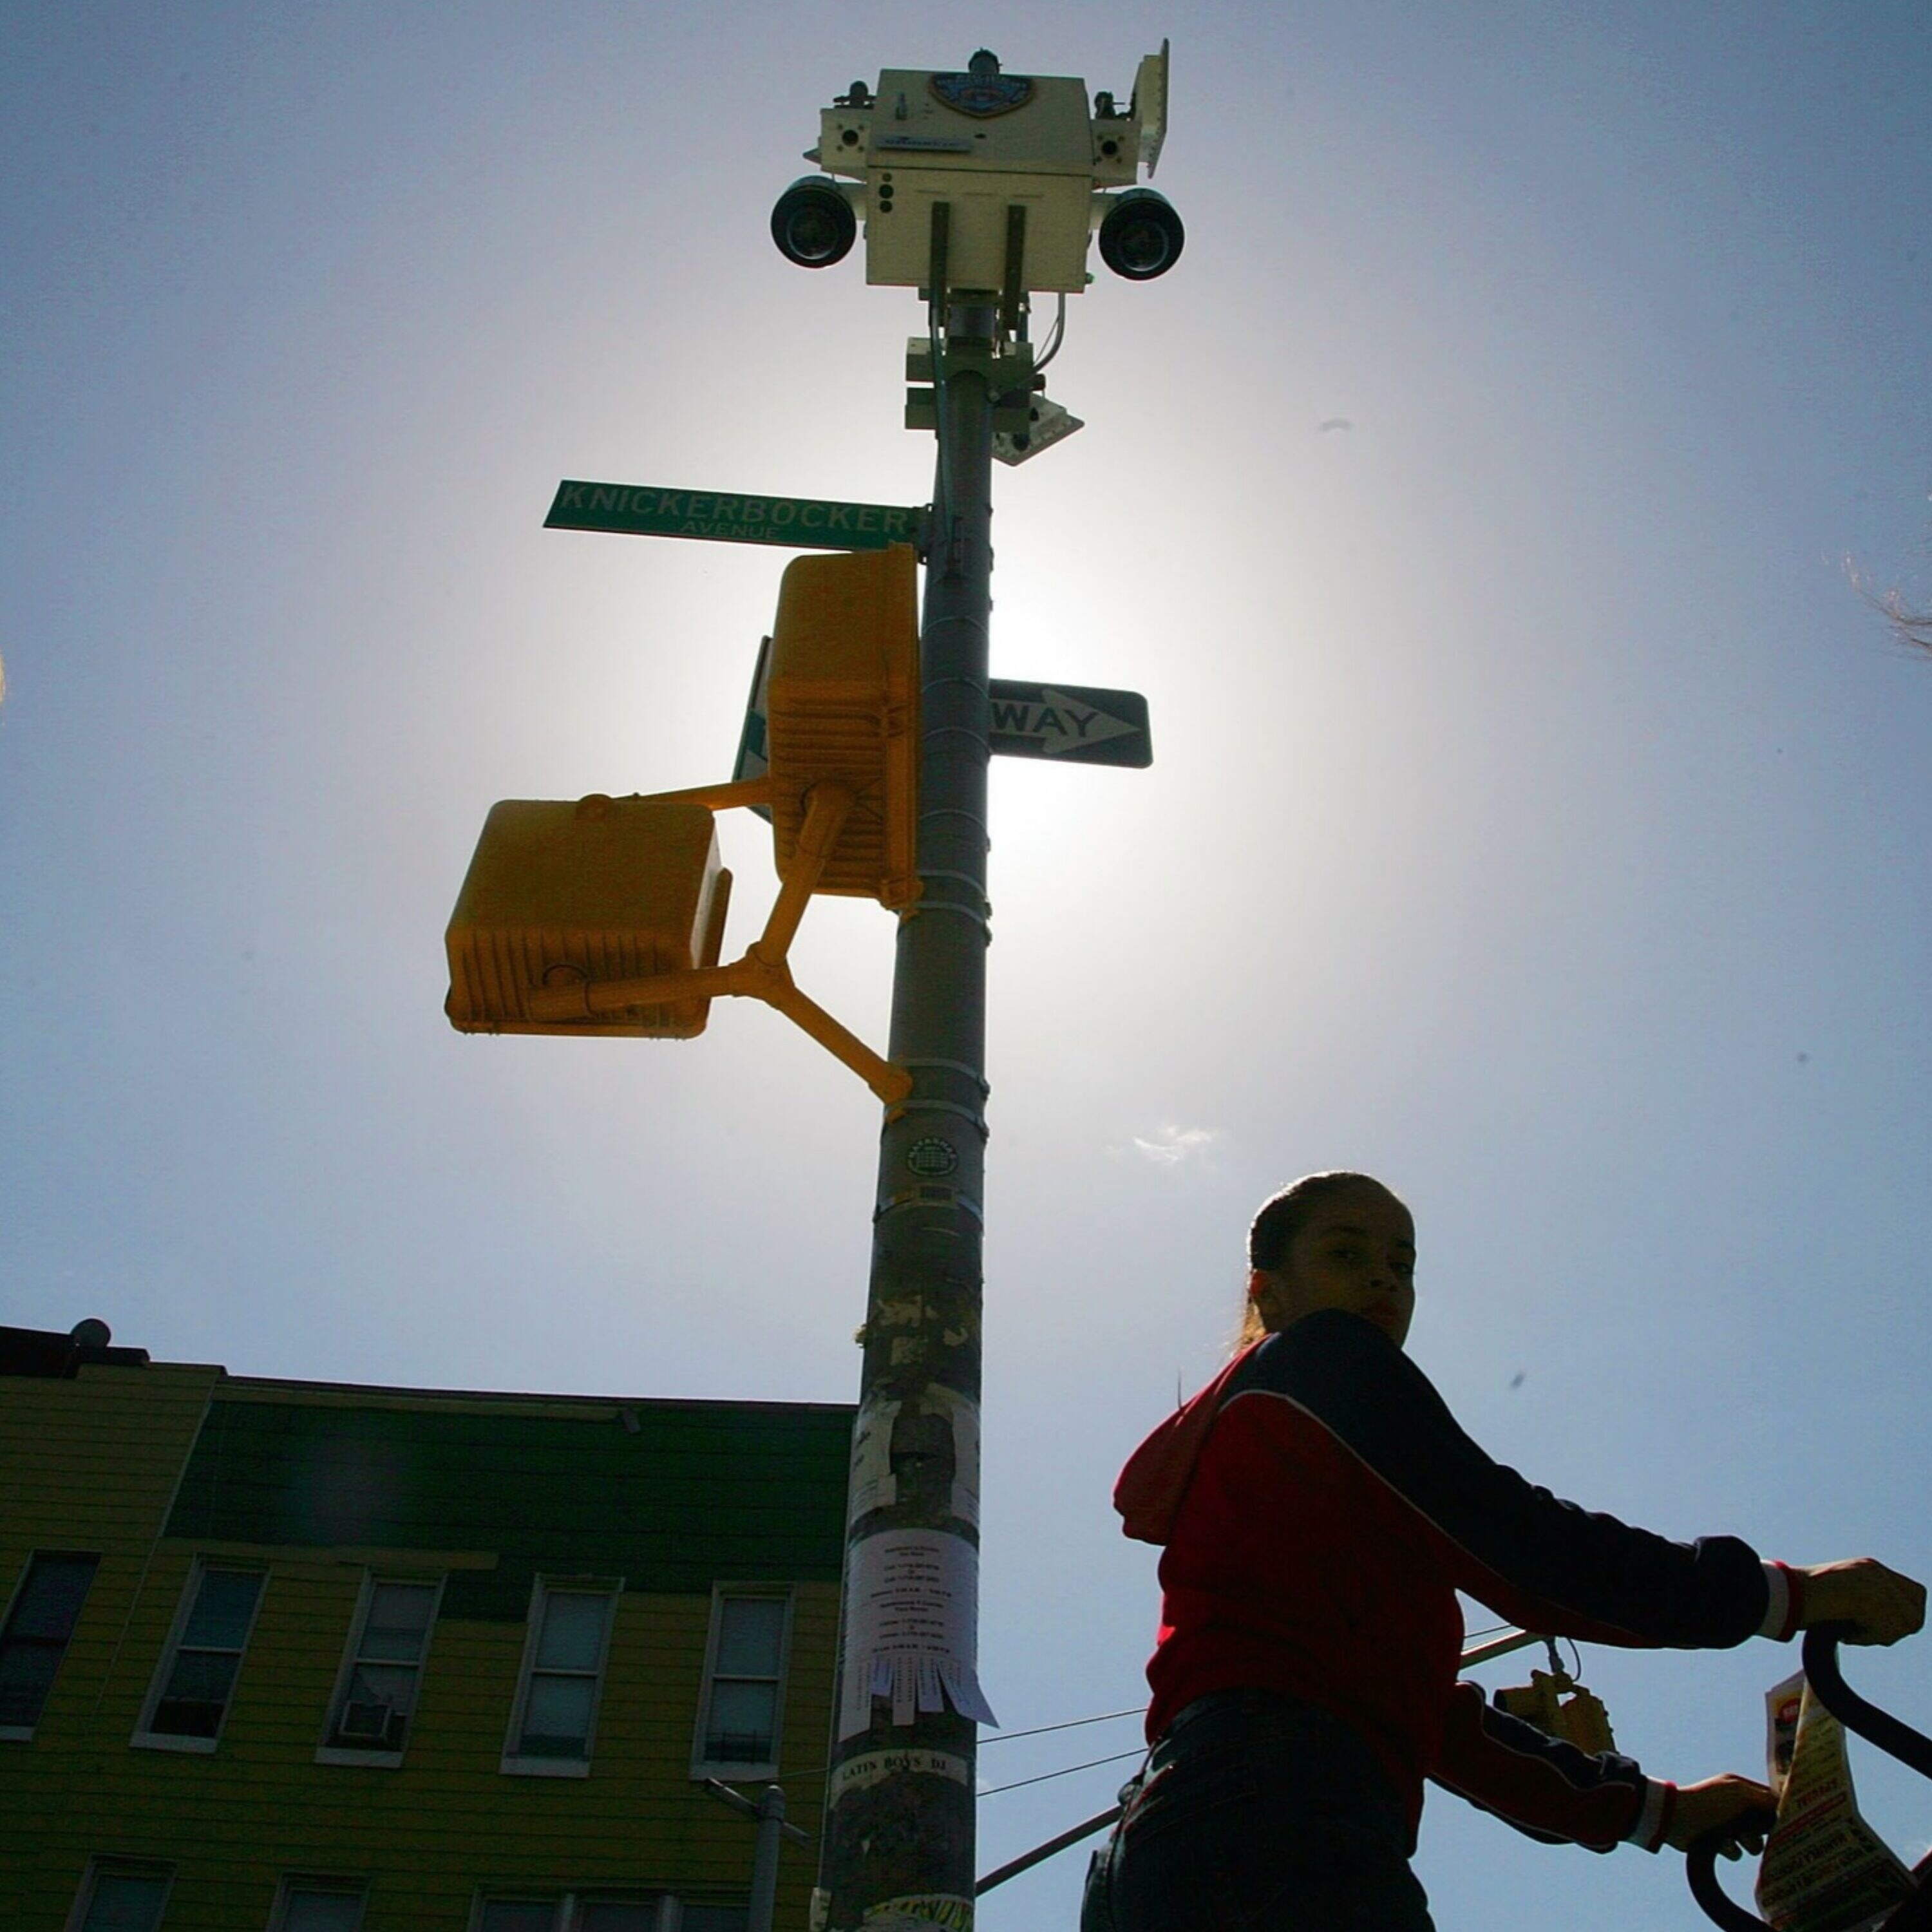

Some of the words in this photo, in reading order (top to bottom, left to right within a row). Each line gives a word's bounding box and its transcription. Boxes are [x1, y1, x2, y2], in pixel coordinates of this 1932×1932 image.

[562, 486, 907, 533] KNICKERBOCKER
[679, 520, 779, 539] AVENUE
[992, 703, 1099, 737] WAY
[842, 1760, 877, 1781] LATIN
